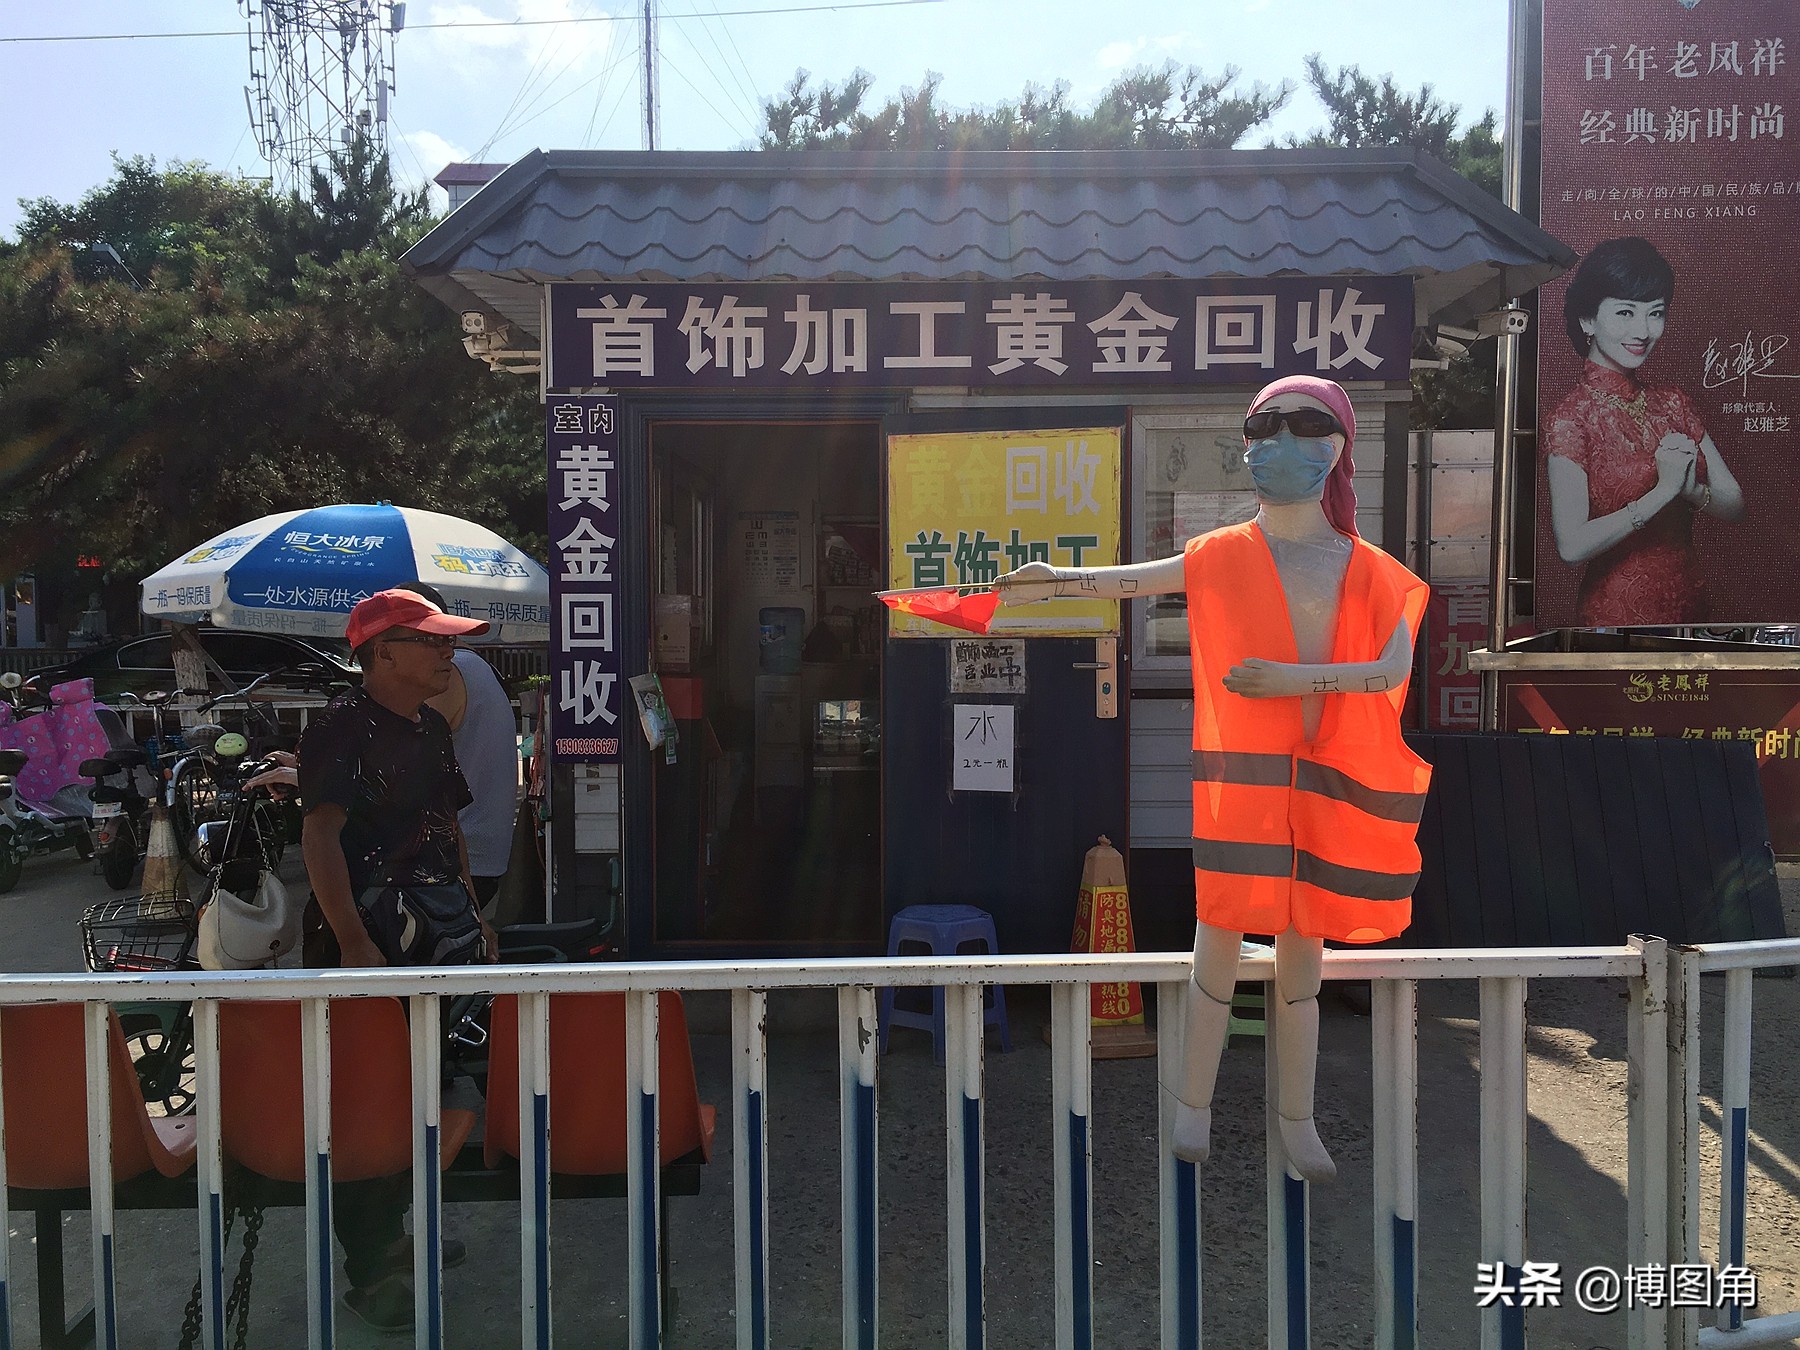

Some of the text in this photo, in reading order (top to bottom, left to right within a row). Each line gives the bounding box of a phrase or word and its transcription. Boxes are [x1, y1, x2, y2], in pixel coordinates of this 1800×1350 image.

[1579, 37, 1786, 81] 百年老凤祥
[1579, 103, 1785, 145] 经典新时尚
[1614, 205, 1757, 221] LAO FENG XIANG
[577, 287, 1386, 377] 首饰加工黄金回收
[553, 404, 615, 434] 室内
[1743, 416, 1790, 432] 赵雅芝
[906, 440, 1101, 521] 黄金回收
[284, 531, 384, 551] 恒大冰泉
[148, 585, 211, 608] 一瓶一码保质量
[556, 444, 618, 726] 黄金回收
[1312, 675, 1388, 692] 出口
[1657, 693, 1709, 702] SINCE1848
[965, 710, 998, 746] 水
[556, 738, 618, 755] 15903336627
